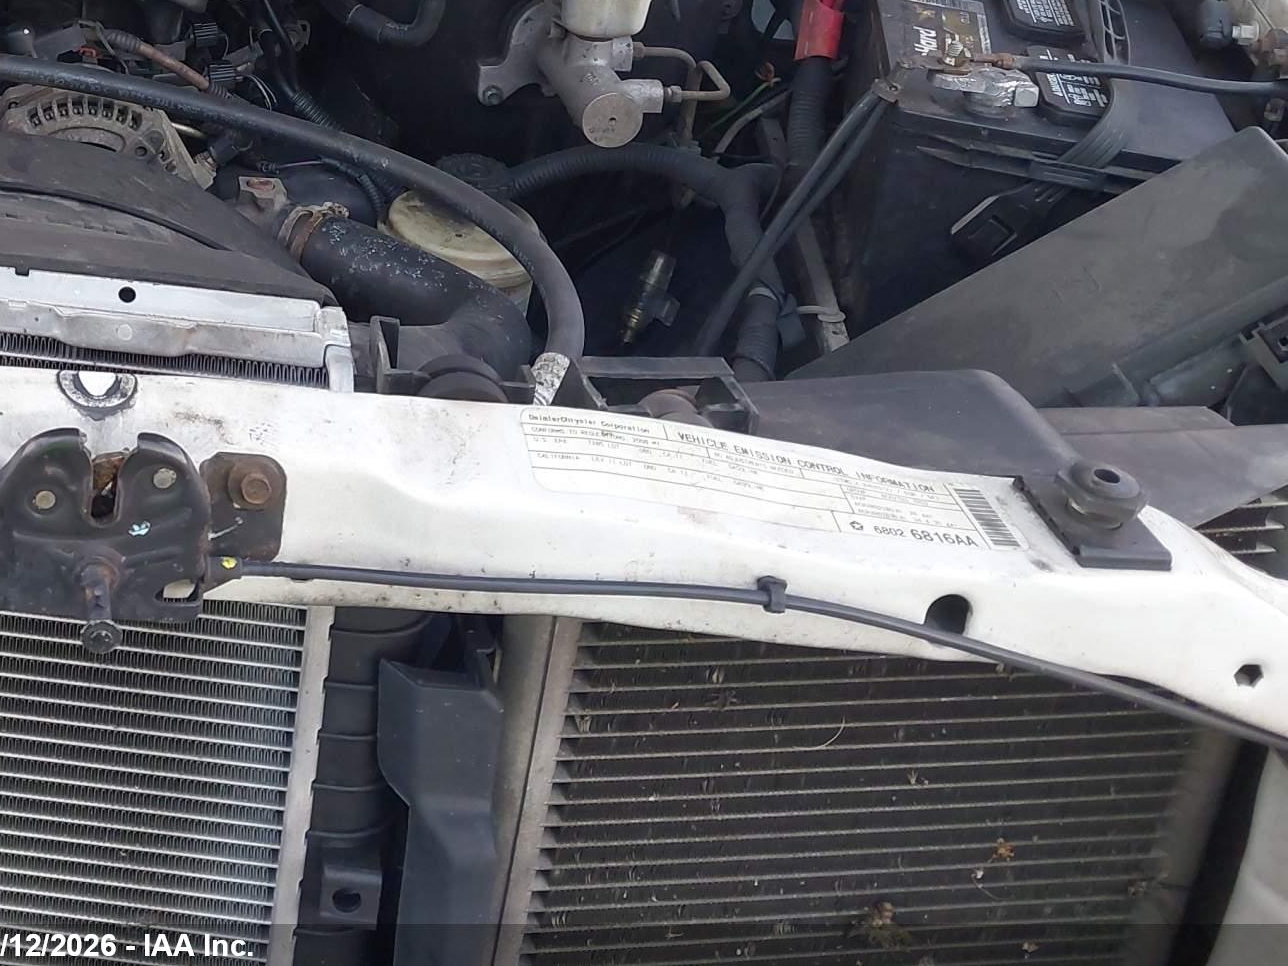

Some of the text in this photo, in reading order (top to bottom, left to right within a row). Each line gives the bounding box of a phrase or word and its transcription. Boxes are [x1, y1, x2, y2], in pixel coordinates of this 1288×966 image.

[600, 420, 650, 434] Corporation
[678, 431, 728, 450] VEHICLE
[733, 444, 792, 465] EMISSION
[797, 459, 848, 476] CONTROL
[856, 471, 935, 493] INFORMATION
[874, 525, 979, 548] 6802 6816AA
